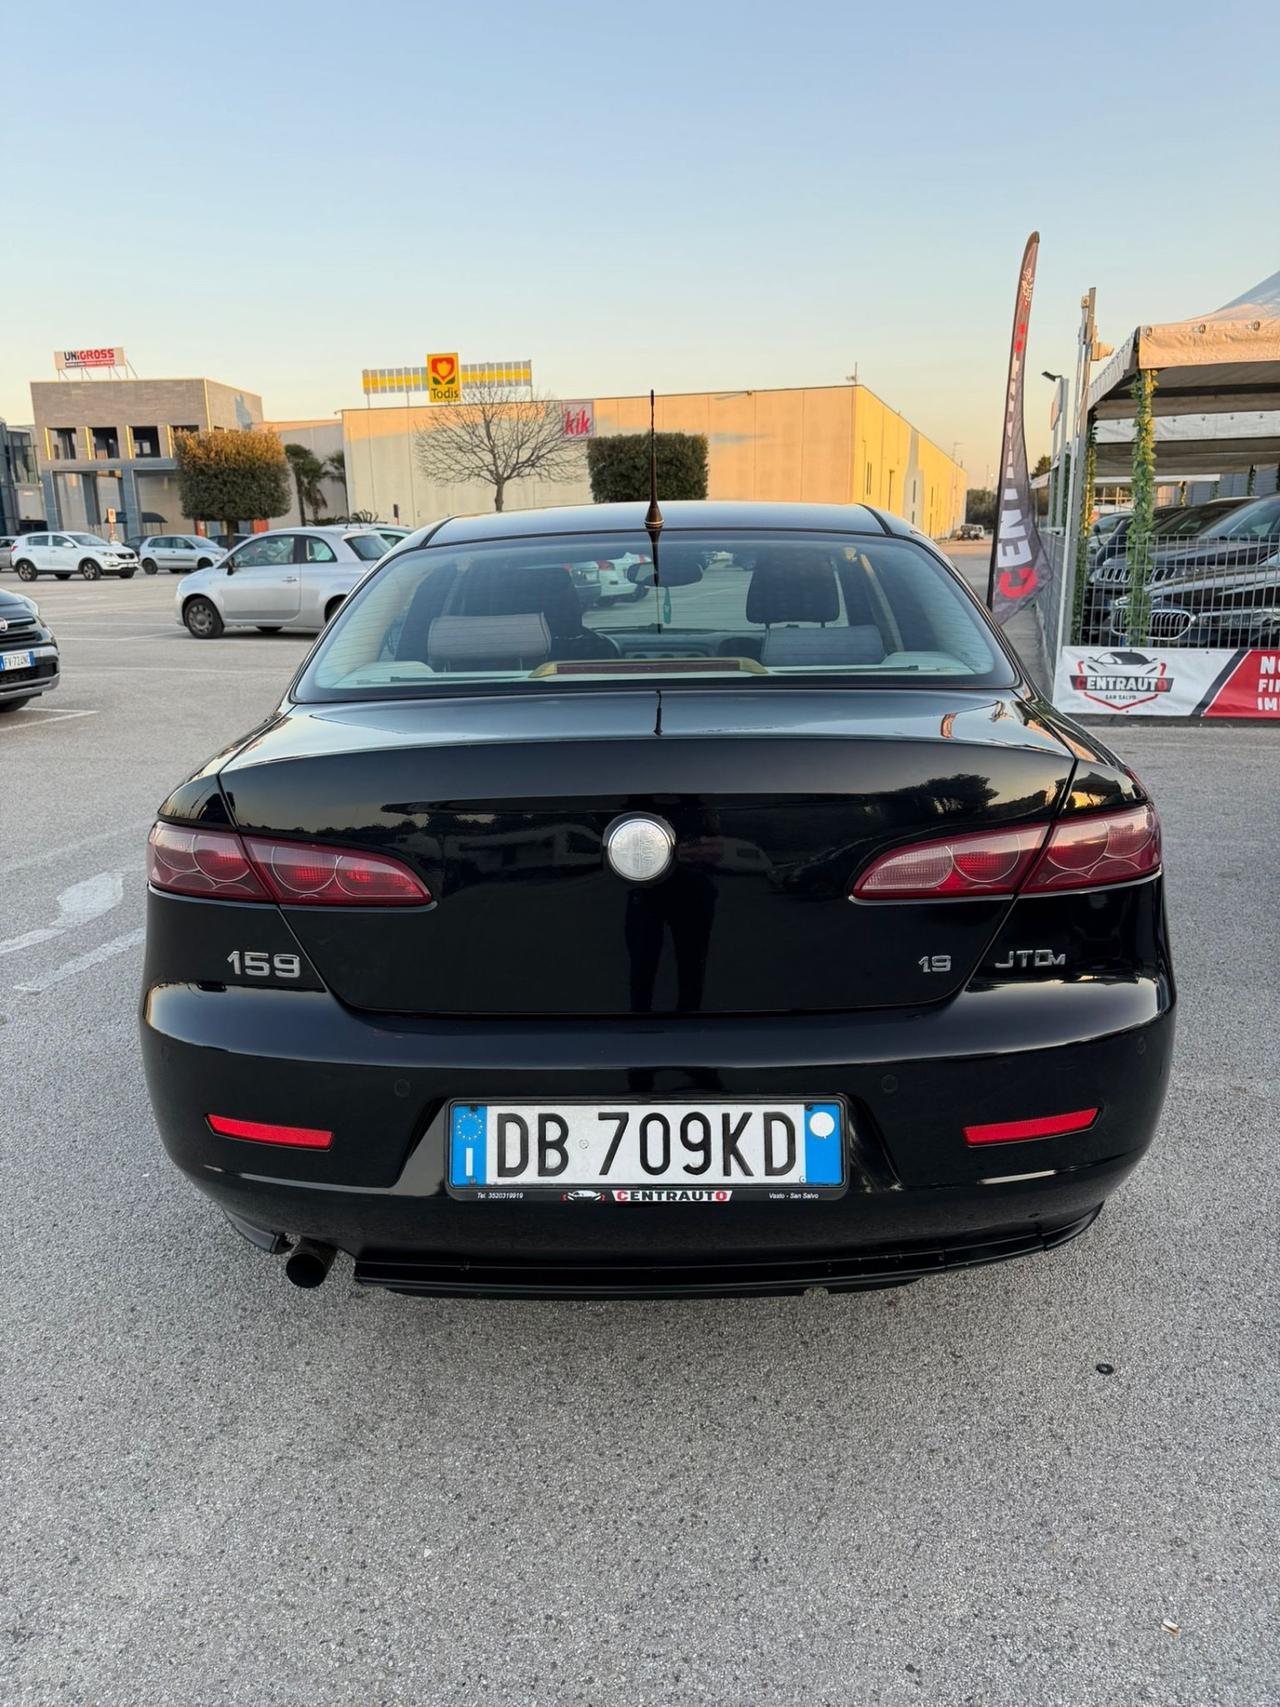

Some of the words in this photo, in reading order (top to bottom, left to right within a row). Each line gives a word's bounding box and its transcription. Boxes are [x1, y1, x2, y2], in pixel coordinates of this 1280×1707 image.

[431, 387, 459, 399] Todis
[564, 405, 590, 435] kik
[1260, 656, 1280, 674] N
[1075, 676, 1168, 692] CENTRAUTO
[227, 950, 301, 978] 159
[497, 1112, 570, 1178] DB
[597, 1111, 797, 1177] 709KD
[616, 1190, 728, 1202] CENTRAUTO
